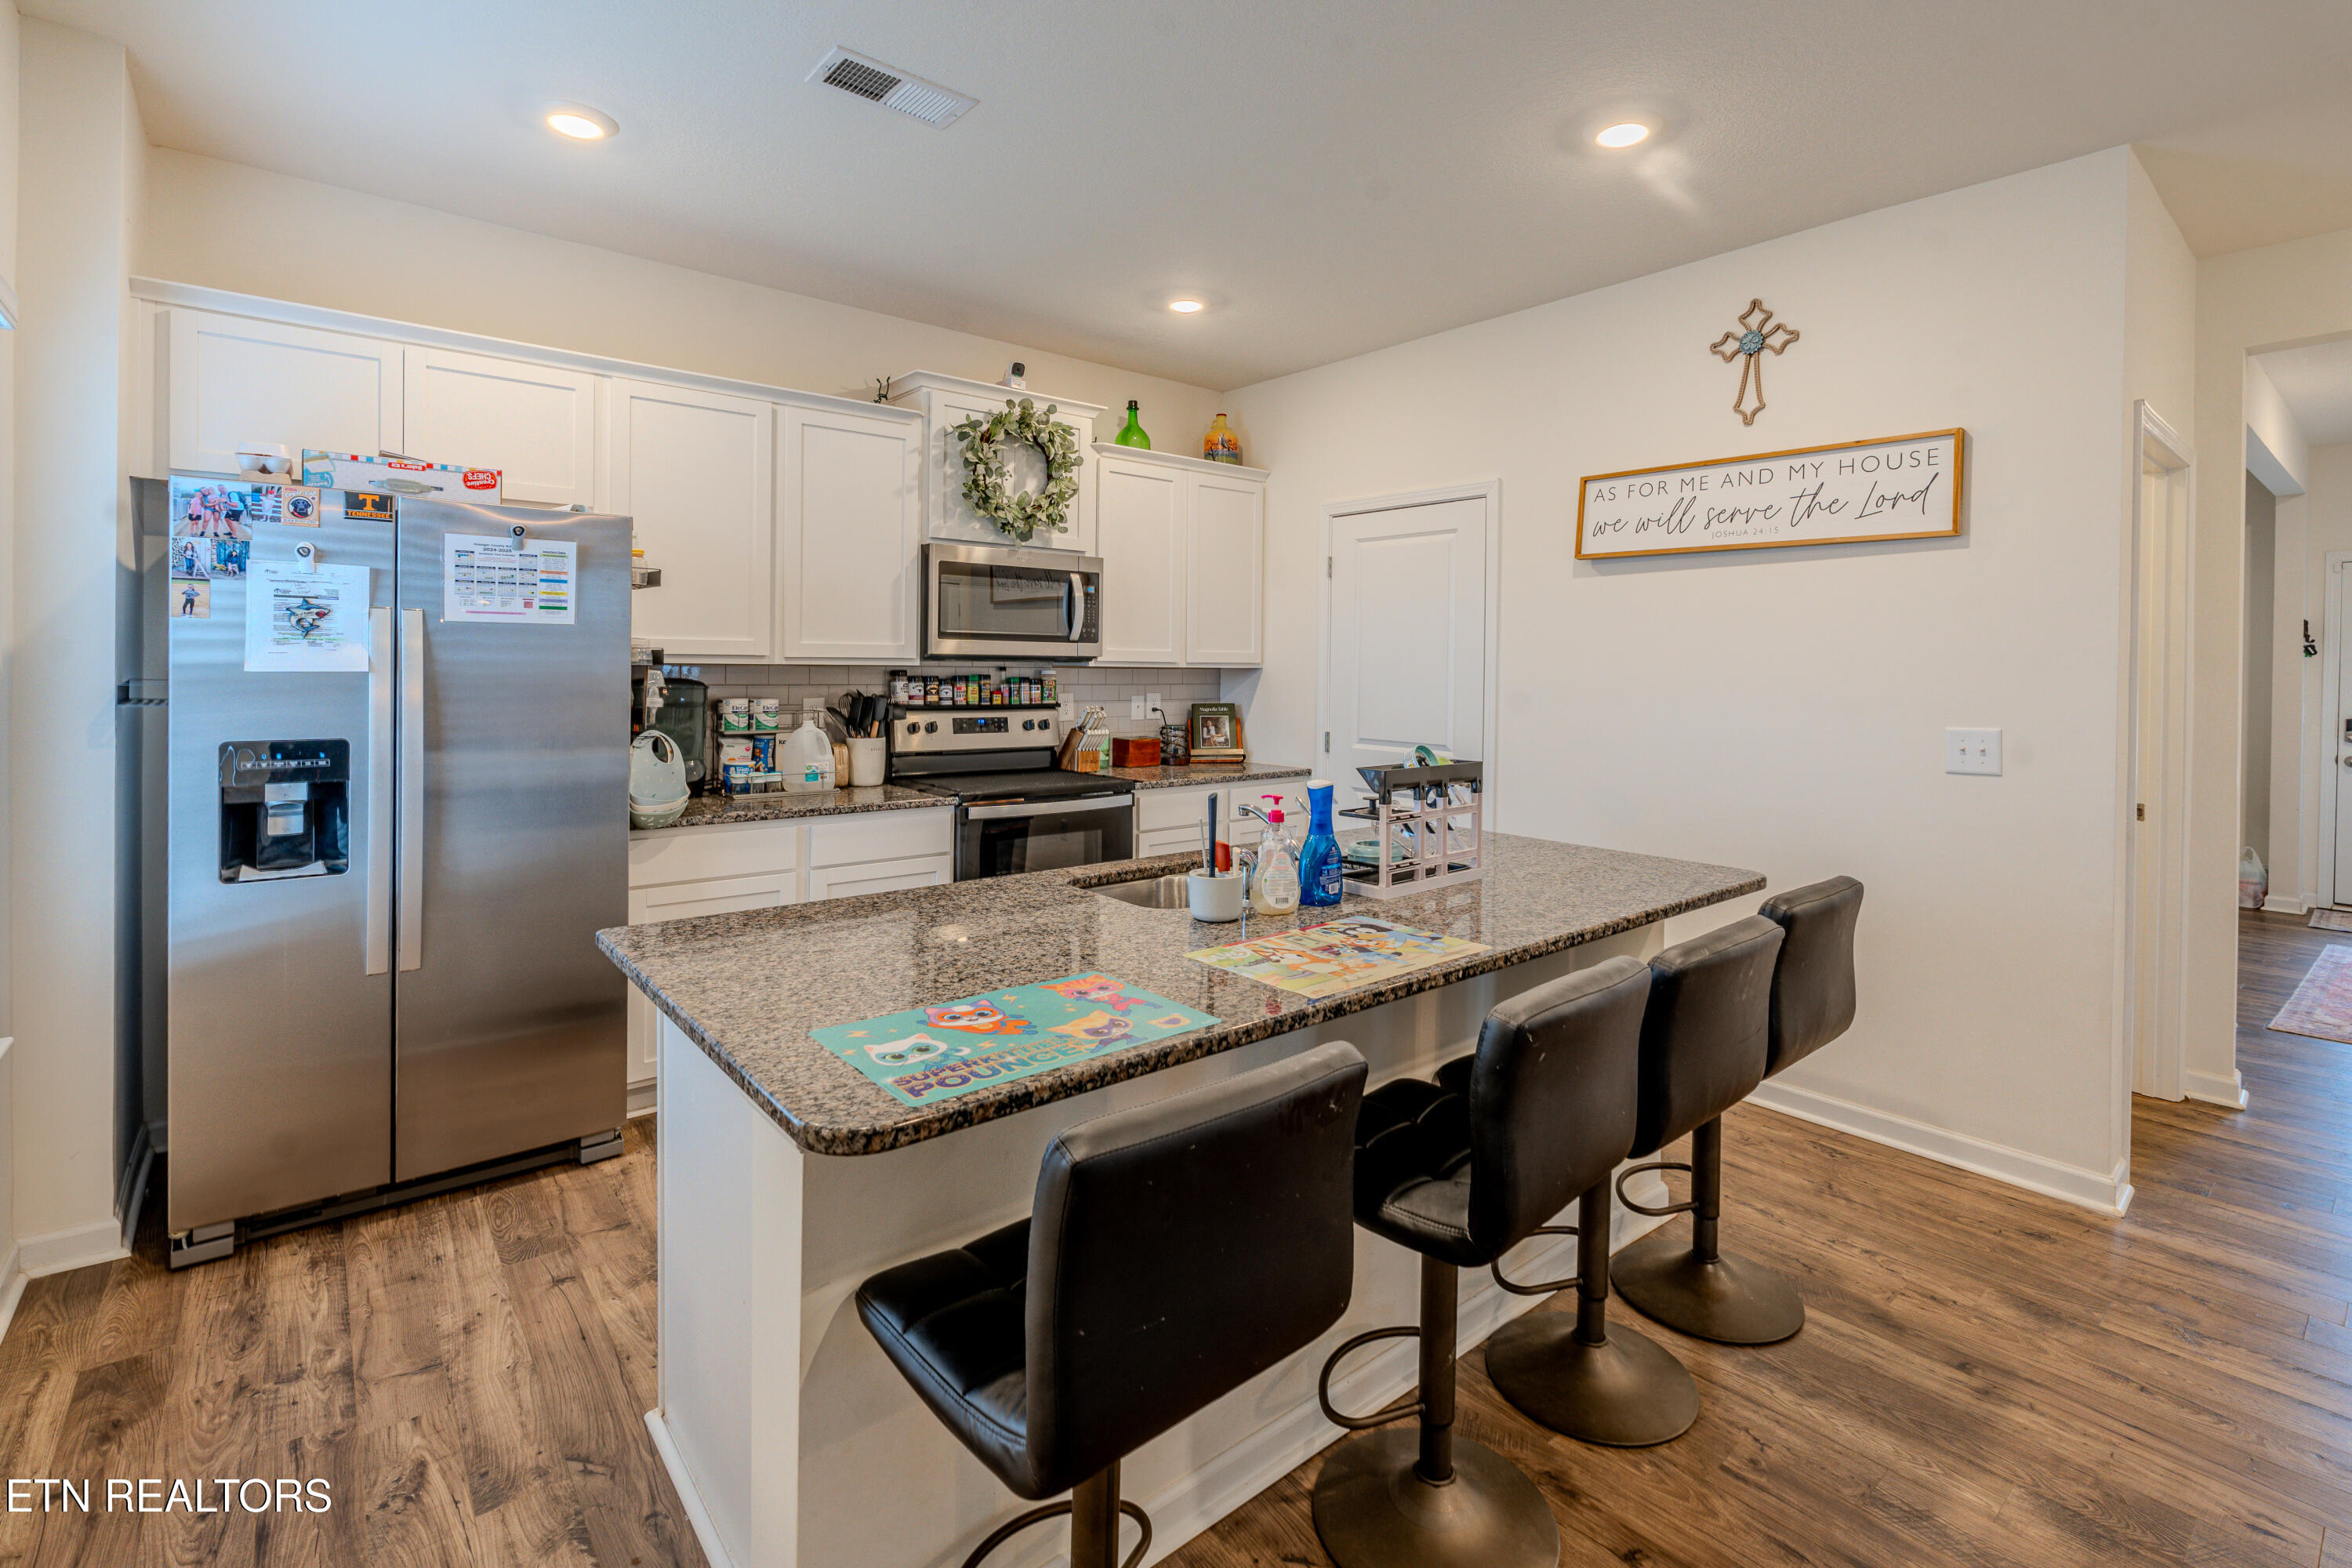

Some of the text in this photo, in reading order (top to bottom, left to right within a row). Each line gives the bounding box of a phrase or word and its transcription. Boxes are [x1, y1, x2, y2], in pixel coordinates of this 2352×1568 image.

[467, 472, 492, 481] CHEFS
[1594, 448, 1939, 503] AS FOR ME AND MY HOUSE
[358, 493, 379, 511] T
[1592, 472, 1940, 537] we will serve the Lord
[347, 510, 390, 519] TENNESSEE
[1711, 526, 1779, 539] JOSHUA 24:15
